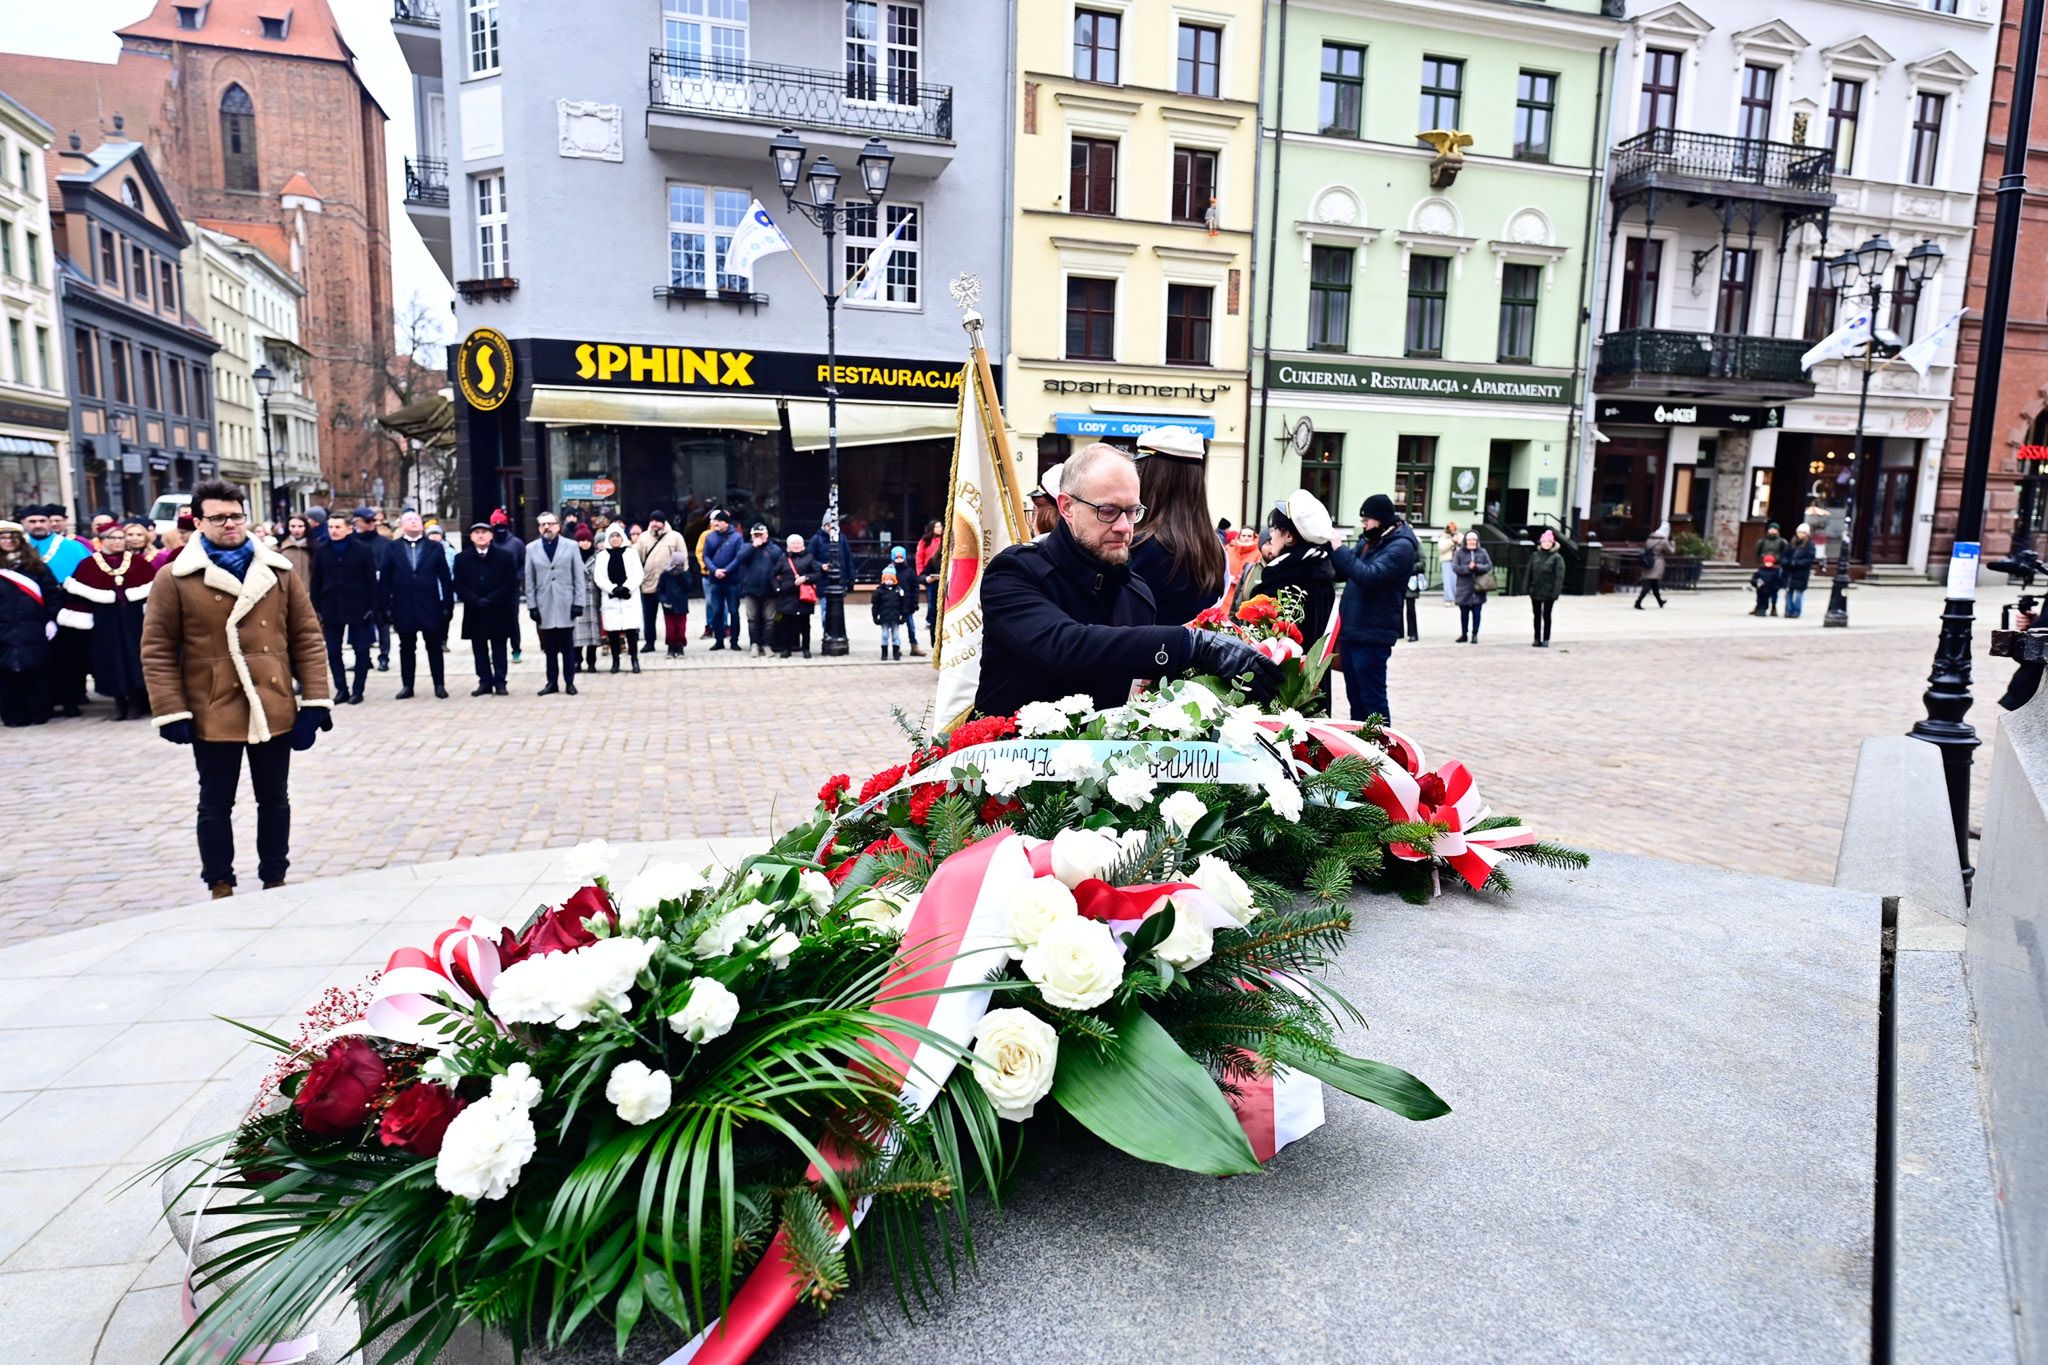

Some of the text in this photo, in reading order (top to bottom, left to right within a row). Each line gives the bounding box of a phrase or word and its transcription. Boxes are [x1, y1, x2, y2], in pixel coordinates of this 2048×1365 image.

[575, 343, 755, 387] SPHINX
[817, 364, 961, 389] RESTAURACJA
[1043, 378, 1216, 403] apartamenty
[1279, 366, 1563, 398] CUKIERNIA RESTAURACJA APARTAMENTY
[1078, 422, 1107, 433] LODY
[1016, 451, 1023, 462] 3
